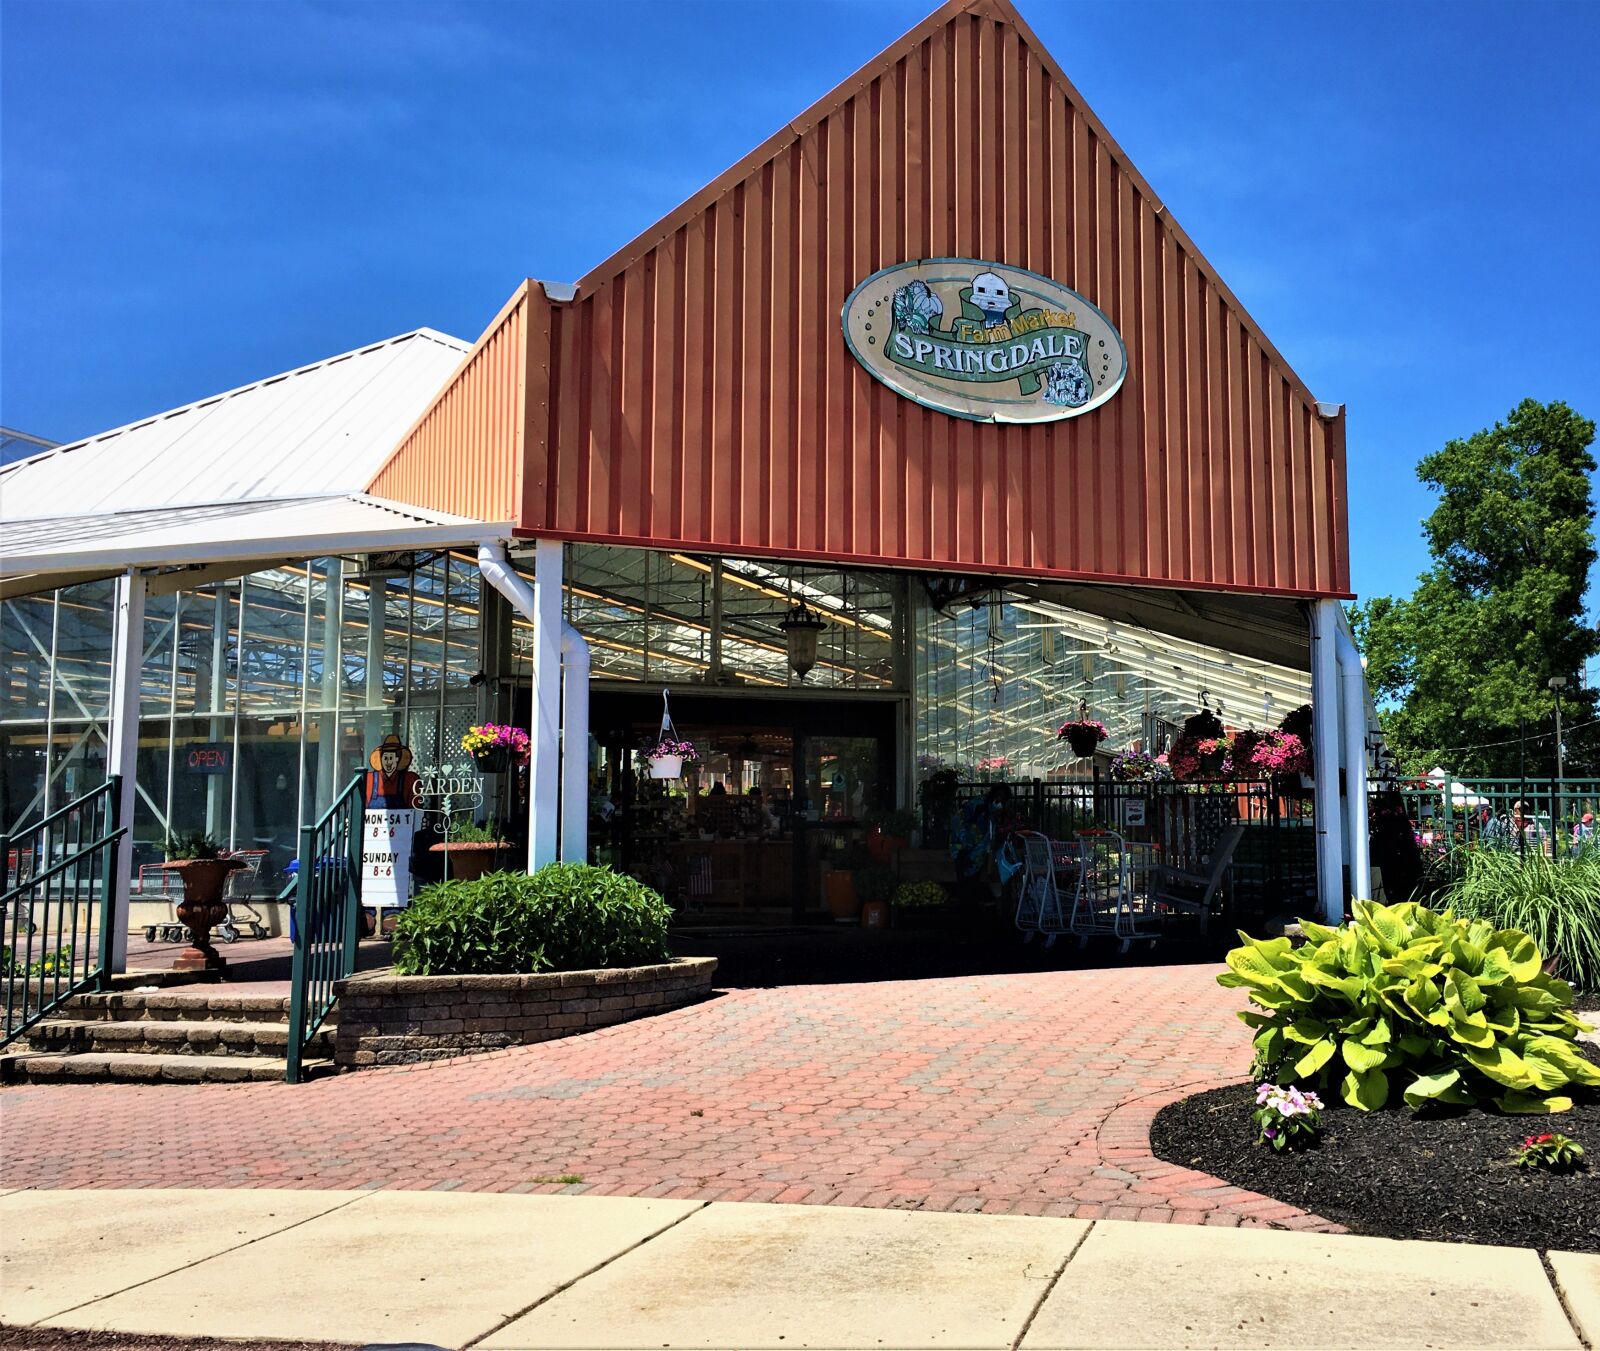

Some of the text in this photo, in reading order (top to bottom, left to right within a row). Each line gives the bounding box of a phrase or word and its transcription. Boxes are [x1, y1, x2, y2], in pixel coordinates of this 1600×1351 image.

[960, 308, 1077, 343] Farm Market
[894, 334, 1083, 374] SPRINGDALE
[187, 750, 228, 768] OPEN
[412, 777, 485, 796] GARDEN
[362, 852, 399, 863] SUNDAY
